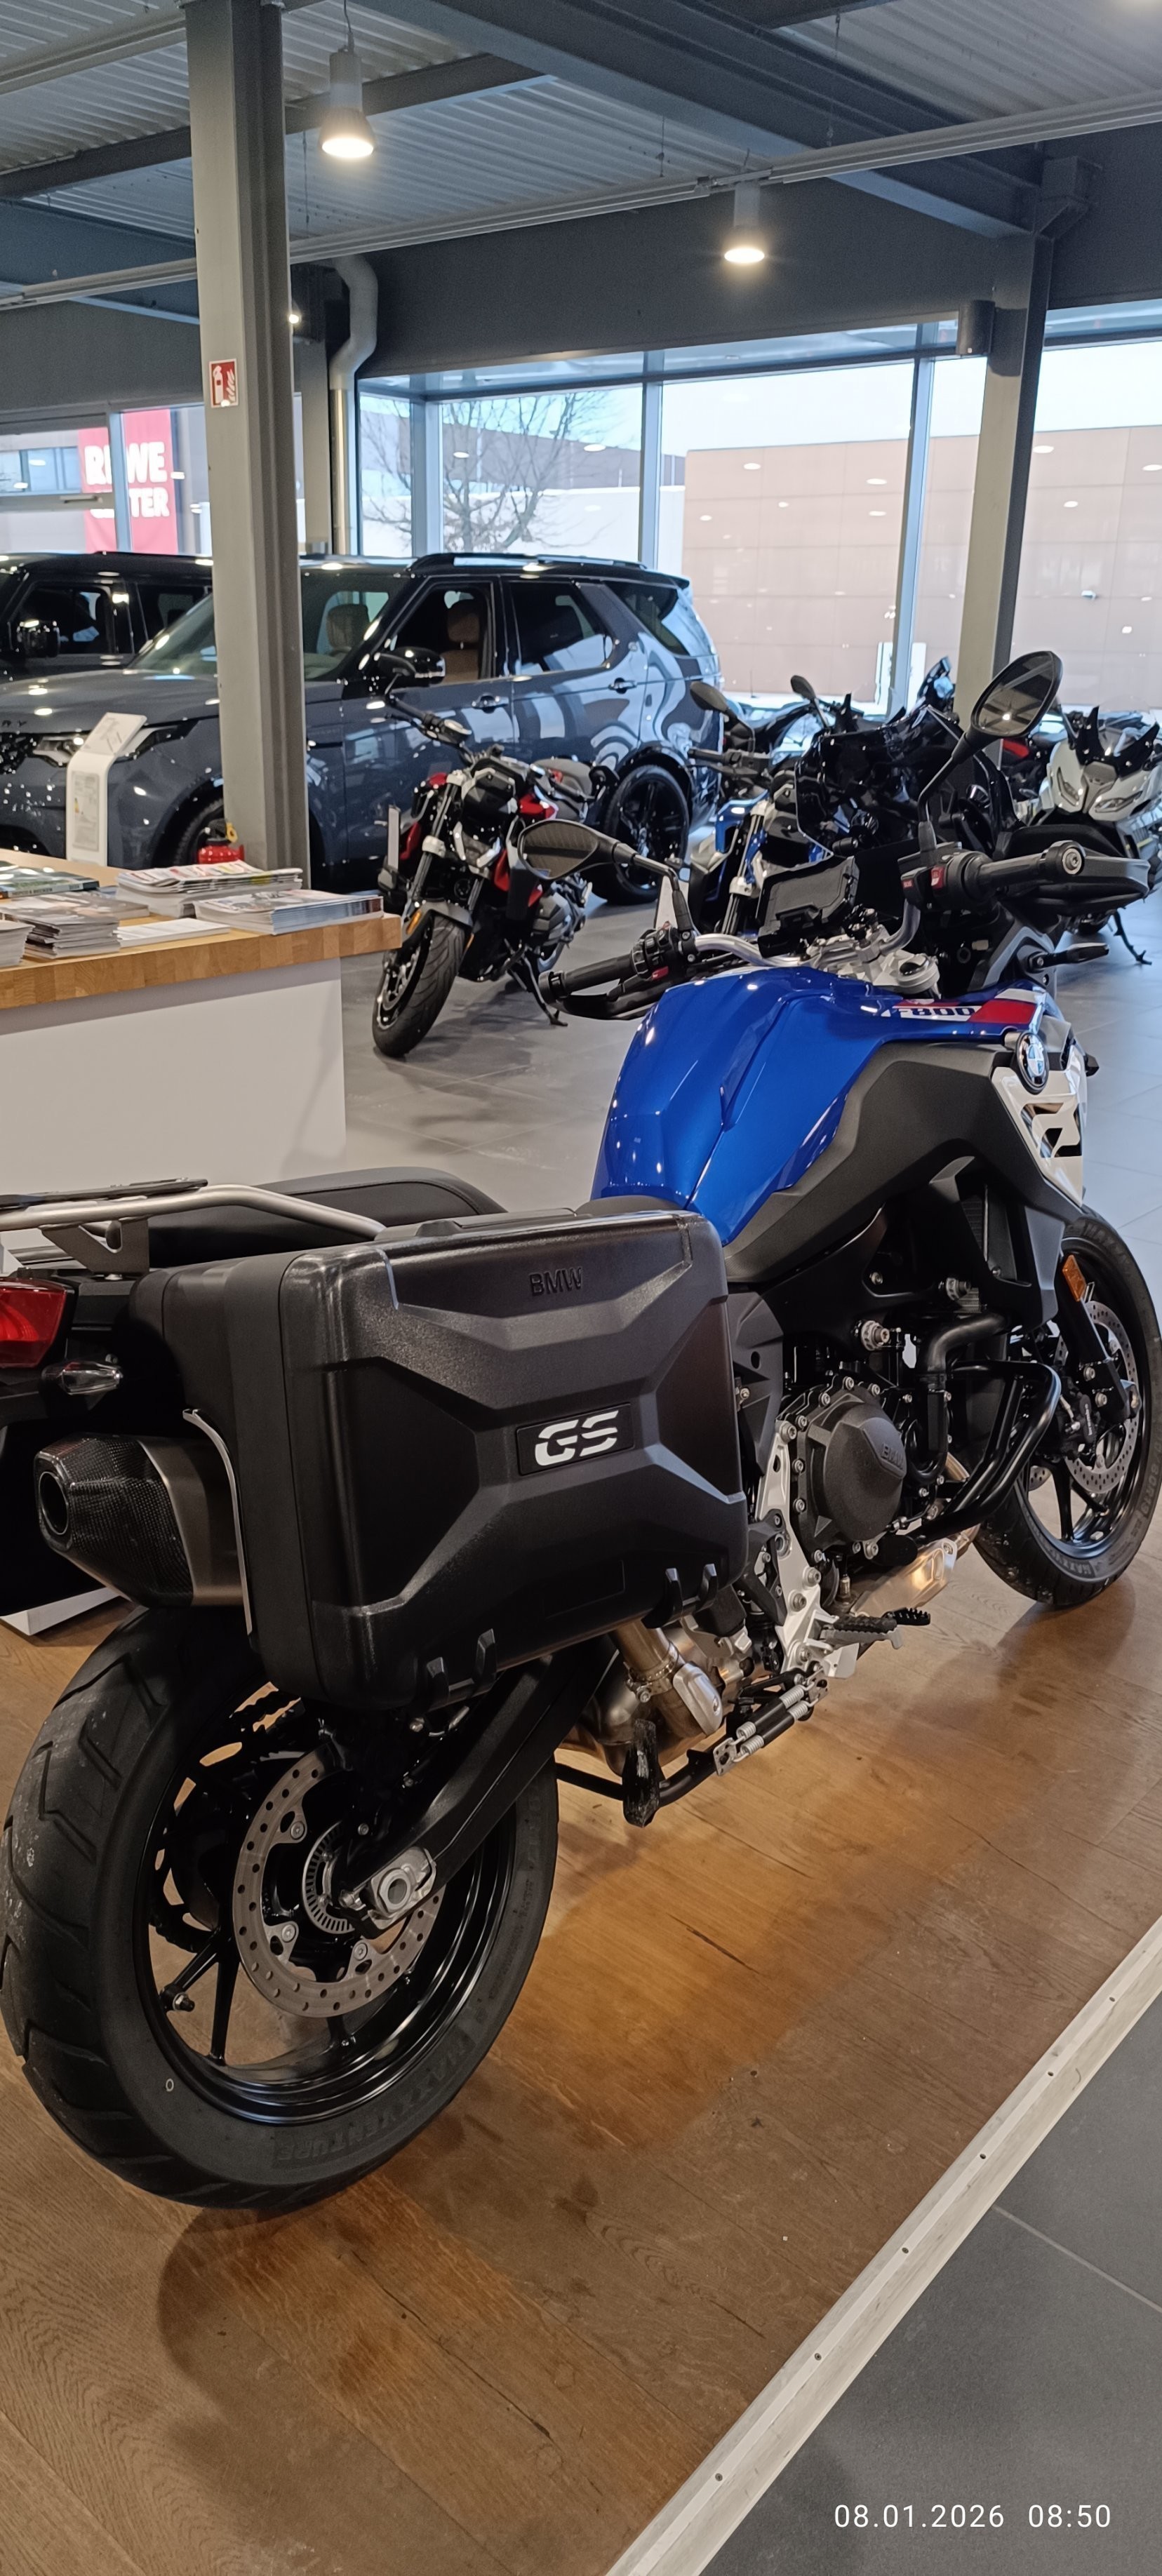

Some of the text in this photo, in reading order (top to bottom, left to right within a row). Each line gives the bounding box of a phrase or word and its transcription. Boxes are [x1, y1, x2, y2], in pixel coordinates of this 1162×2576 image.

[529, 1267, 582, 1296] BMW
[535, 1410, 619, 1466] GS
[881, 1443, 904, 1470] BMW
